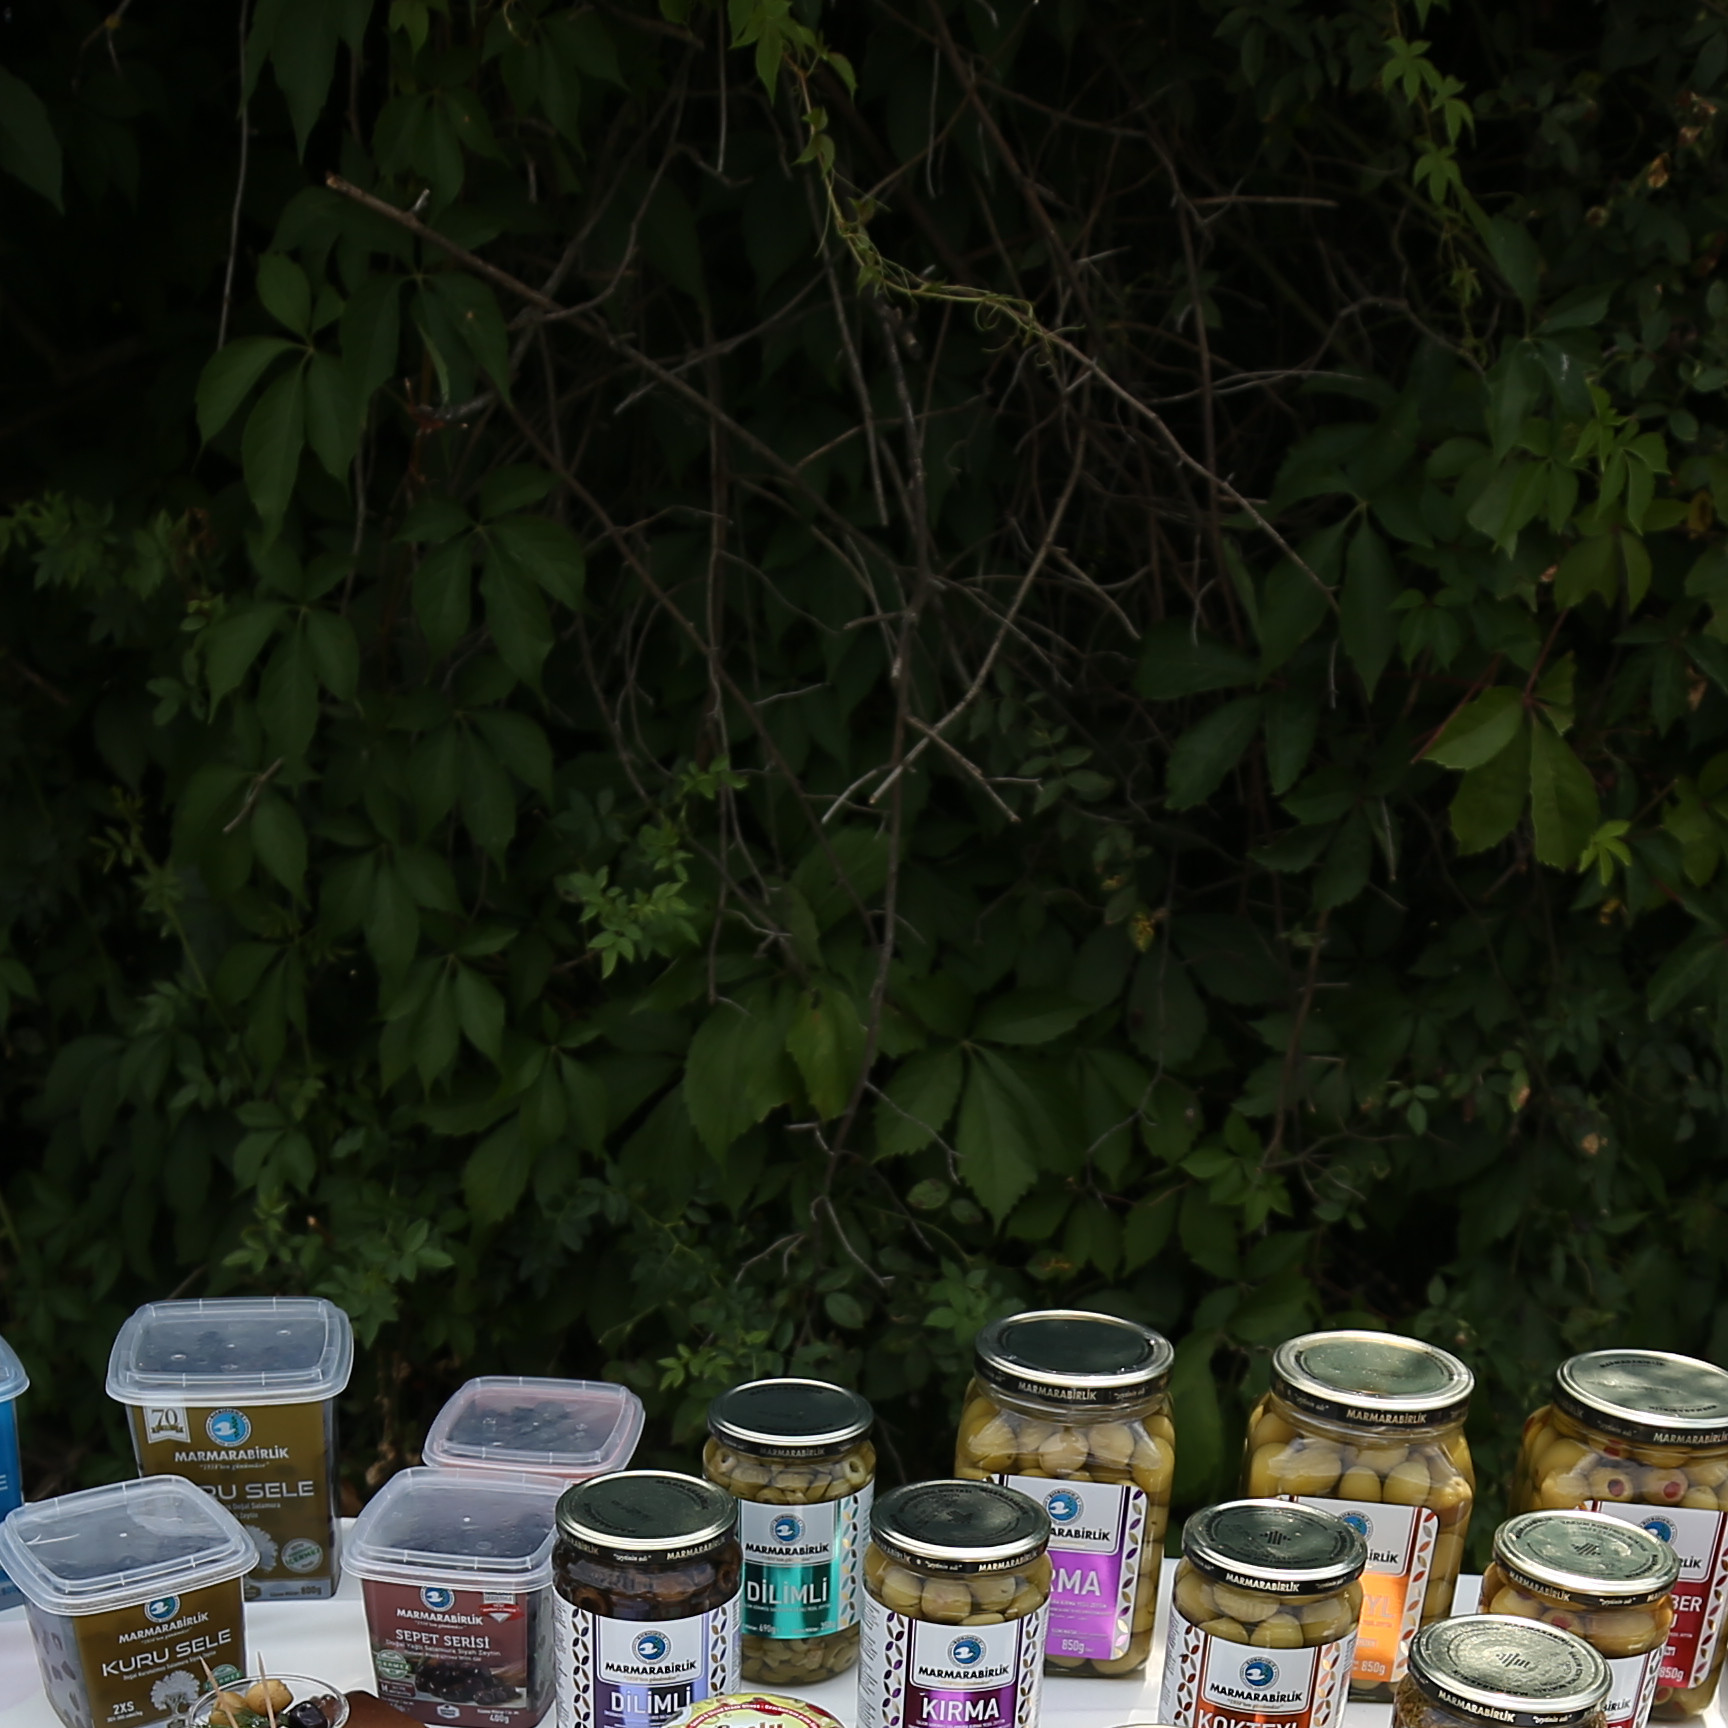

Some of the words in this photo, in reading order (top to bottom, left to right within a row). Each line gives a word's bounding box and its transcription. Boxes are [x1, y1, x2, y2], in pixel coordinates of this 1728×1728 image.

[1018, 1381, 1097, 1401] MARMARABİRLİK
[152, 1409, 177, 1425] 70
[1346, 1407, 1428, 1425] MARMARABİRLİK
[175, 1445, 289, 1462] MARMARABİRLİK
[760, 1447, 825, 1456] MARMARABİRLİK
[245, 1481, 314, 1499] SELE
[1051, 1527, 1110, 1541] ARABİRLİK
[667, 1536, 725, 1560] MARMARABİRLİK
[746, 1543, 829, 1555] MARMARABİRLİK
[978, 1548, 1040, 1572] MARMARABİRLİK
[747, 1577, 827, 1604] DİLİMLİ
[1225, 1572, 1301, 1593] MARMARABİRLİK
[1509, 1571, 1570, 1602] MARMARABİRLİK
[1671, 1595, 1703, 1612] BER
[396, 1608, 483, 1625] MARMARABİRLİK
[119, 1612, 209, 1644] MARMARABİRLİK
[396, 1629, 439, 1645] SEPET
[444, 1634, 490, 1649] SERİSİ
[1062, 1639, 1084, 1654] 850g
[102, 1648, 169, 1676] KURU
[176, 1629, 231, 1658] SELE
[606, 1659, 696, 1675] MARMARABİRLİK
[919, 1664, 1009, 1679] MARMARABİRLİK
[1361, 1660, 1385, 1676] 850g
[612, 1686, 690, 1714] DİLİMLİ
[1210, 1683, 1302, 1703] MARMARABİRLİK
[113, 1702, 134, 1714] 2XS
[922, 1698, 999, 1722] KIRMA
[1438, 1690, 1517, 1723] MARMARABİRLİK
